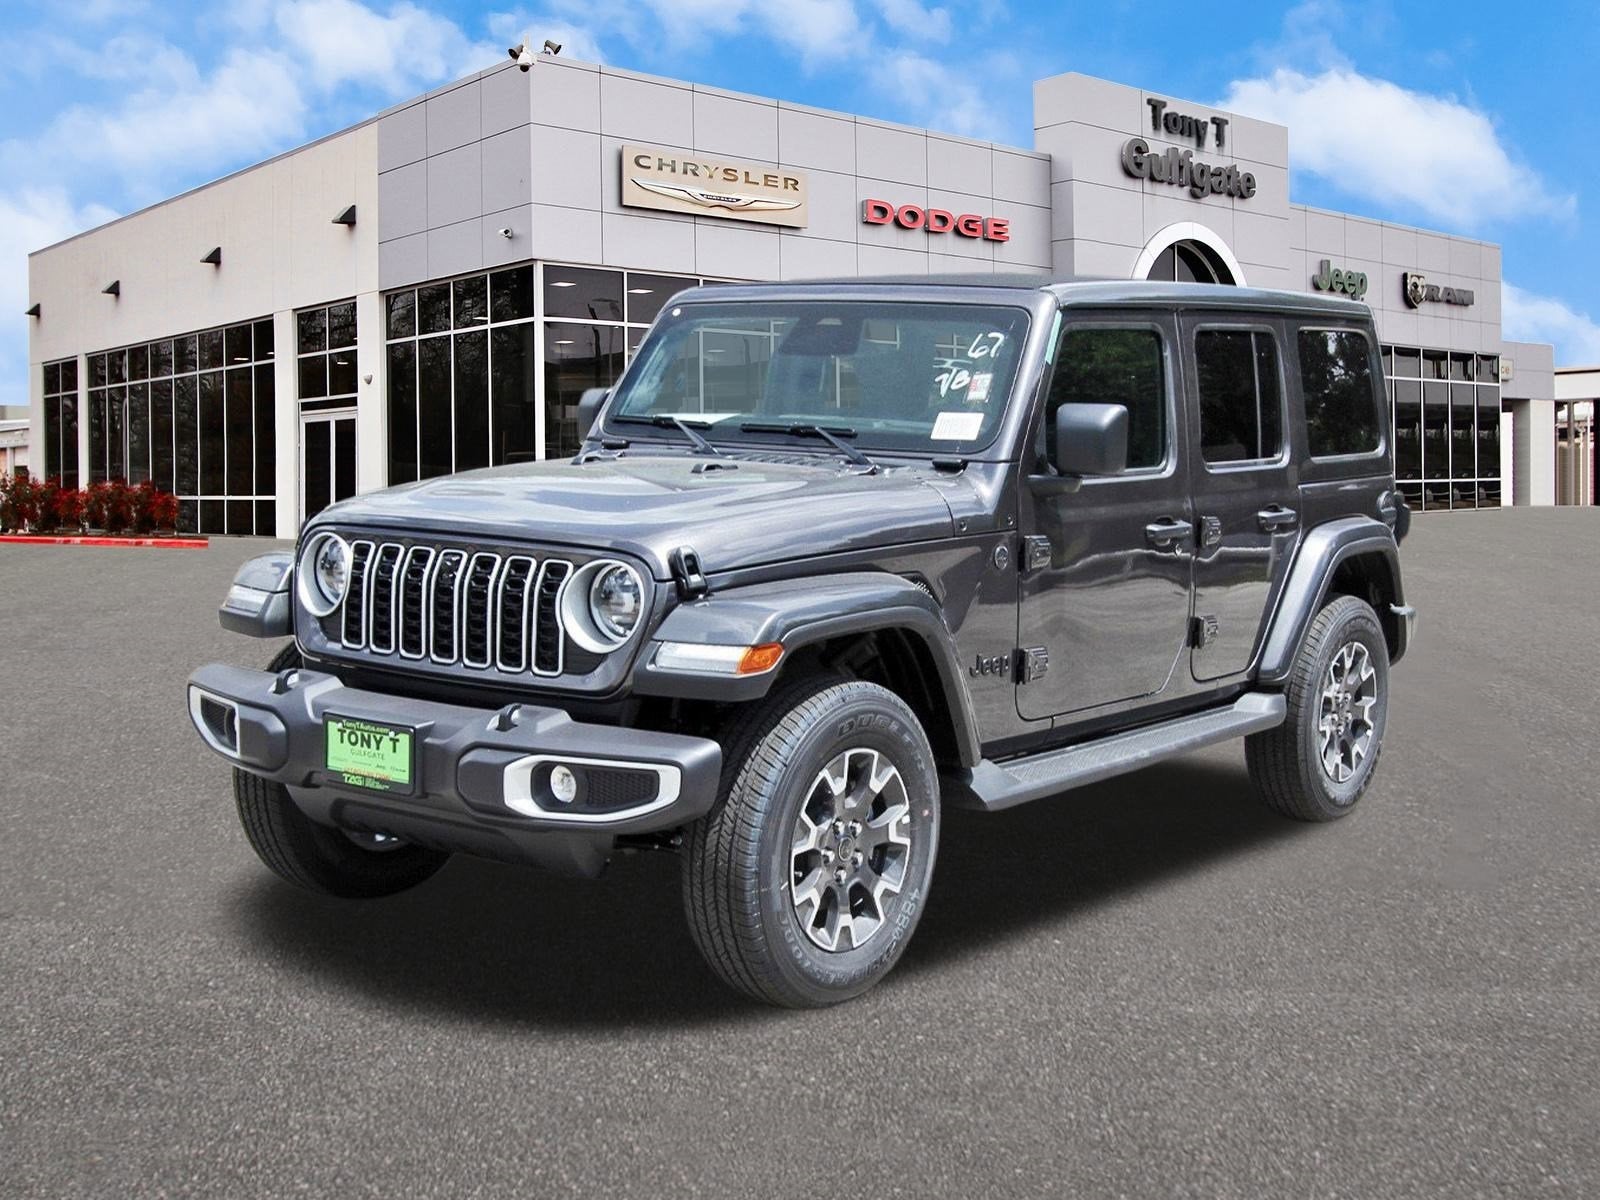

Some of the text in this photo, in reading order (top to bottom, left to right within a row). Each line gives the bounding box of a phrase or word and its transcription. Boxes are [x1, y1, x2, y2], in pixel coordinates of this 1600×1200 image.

[1147, 98, 1229, 148] Tony T
[633, 154, 800, 192] CHRYSLER
[1121, 138, 1256, 199] Gulfgate
[863, 198, 1010, 242] DODGE
[1313, 259, 1368, 301] Jeep
[1424, 284, 1475, 306] RAM
[967, 332, 1005, 359] 67
[969, 654, 1009, 678] Jeep
[337, 728, 400, 754] TONY T
